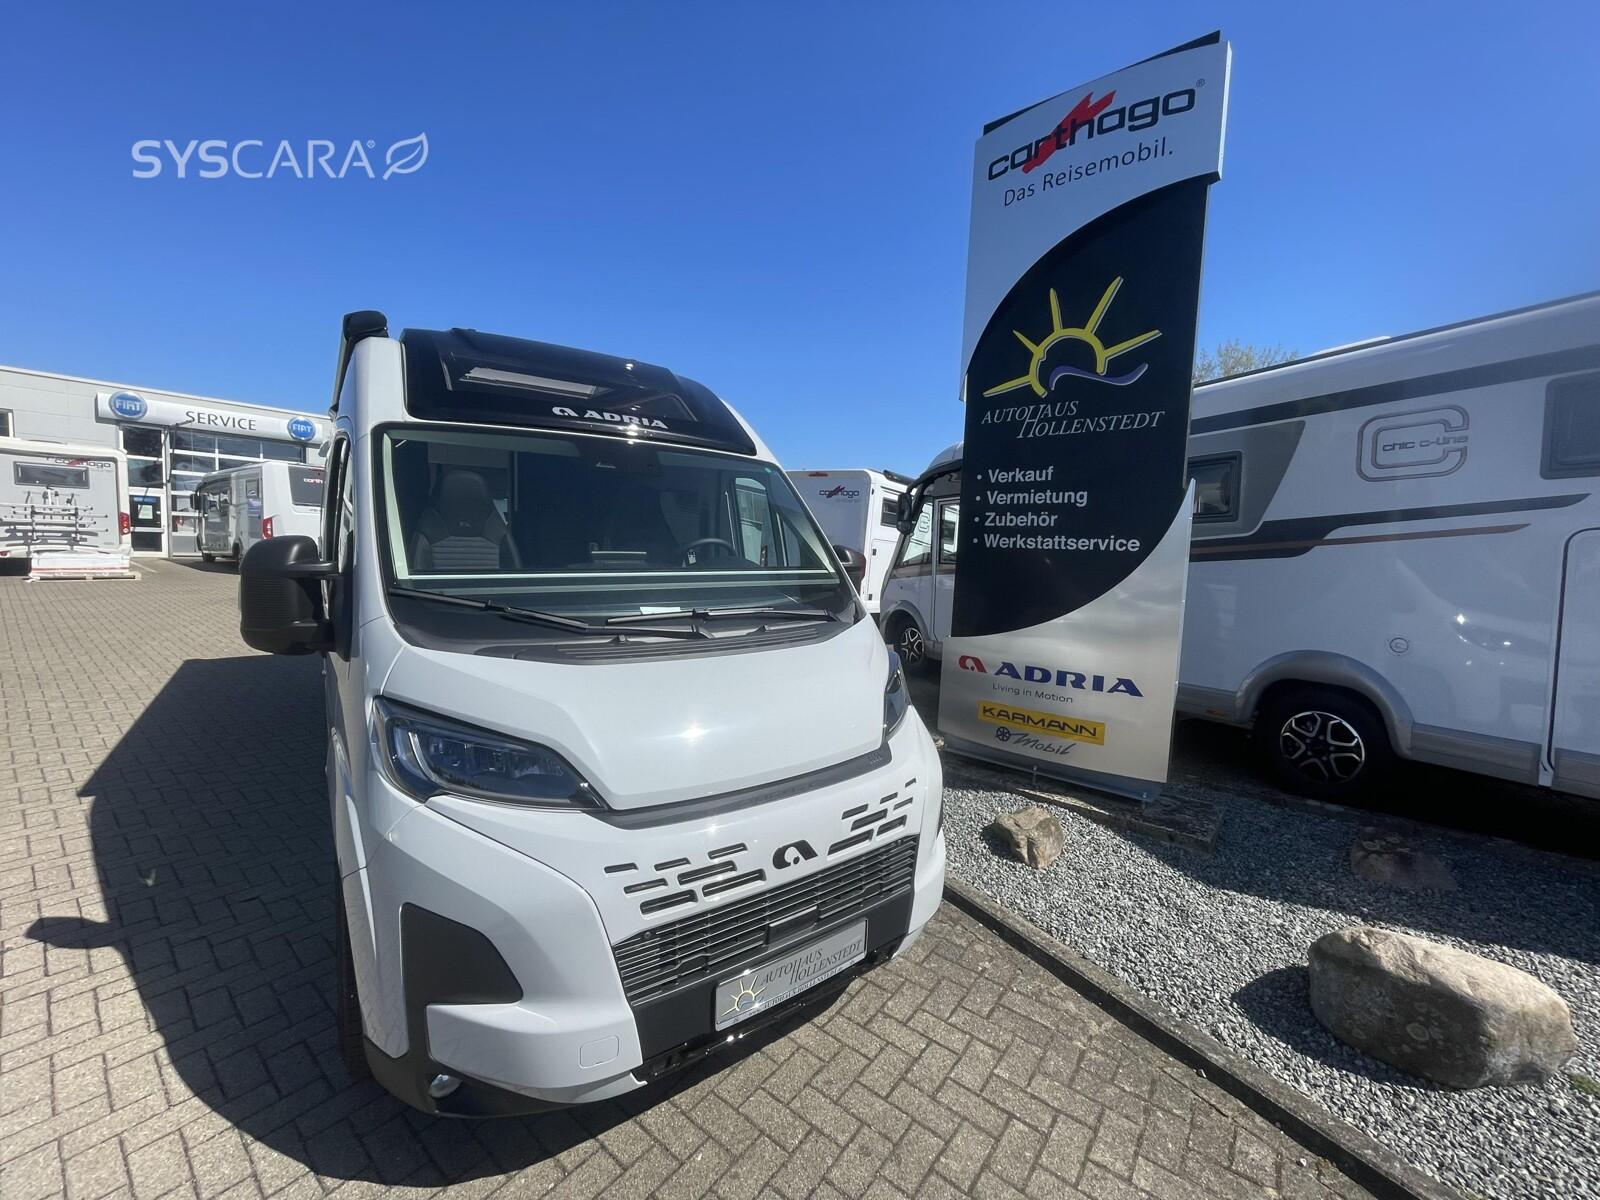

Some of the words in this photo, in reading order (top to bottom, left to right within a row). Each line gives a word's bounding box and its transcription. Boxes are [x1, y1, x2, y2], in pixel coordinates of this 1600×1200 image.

[988, 88, 1196, 180] carthago
[1004, 183, 1036, 207] Das
[1042, 137, 1174, 191] Reisemobil.
[115, 399, 142, 412] FIAT
[981, 401, 1079, 426] AUTOHAUS
[185, 410, 257, 431] SERVICE
[292, 423, 313, 433] FIAT
[583, 409, 669, 429] ADRIA
[1016, 408, 1165, 439] HOLLENSTEDT
[55, 457, 111, 469] cahago
[988, 466, 1054, 483] Verkauf
[987, 489, 1088, 507] Vermietung
[984, 511, 1058, 527] Zubehör
[984, 533, 1141, 551] Werkstattservice
[994, 661, 1144, 697] ADRIA
[992, 683, 1020, 696] Living
[1023, 688, 1032, 697] in
[1035, 691, 1074, 704] Motion
[982, 705, 1097, 737] KARMANN
[1011, 732, 1077, 755] Mobil
[760, 948, 823, 986] AUTOHAUS
[790, 940, 863, 985] HOLLENSTEDT
